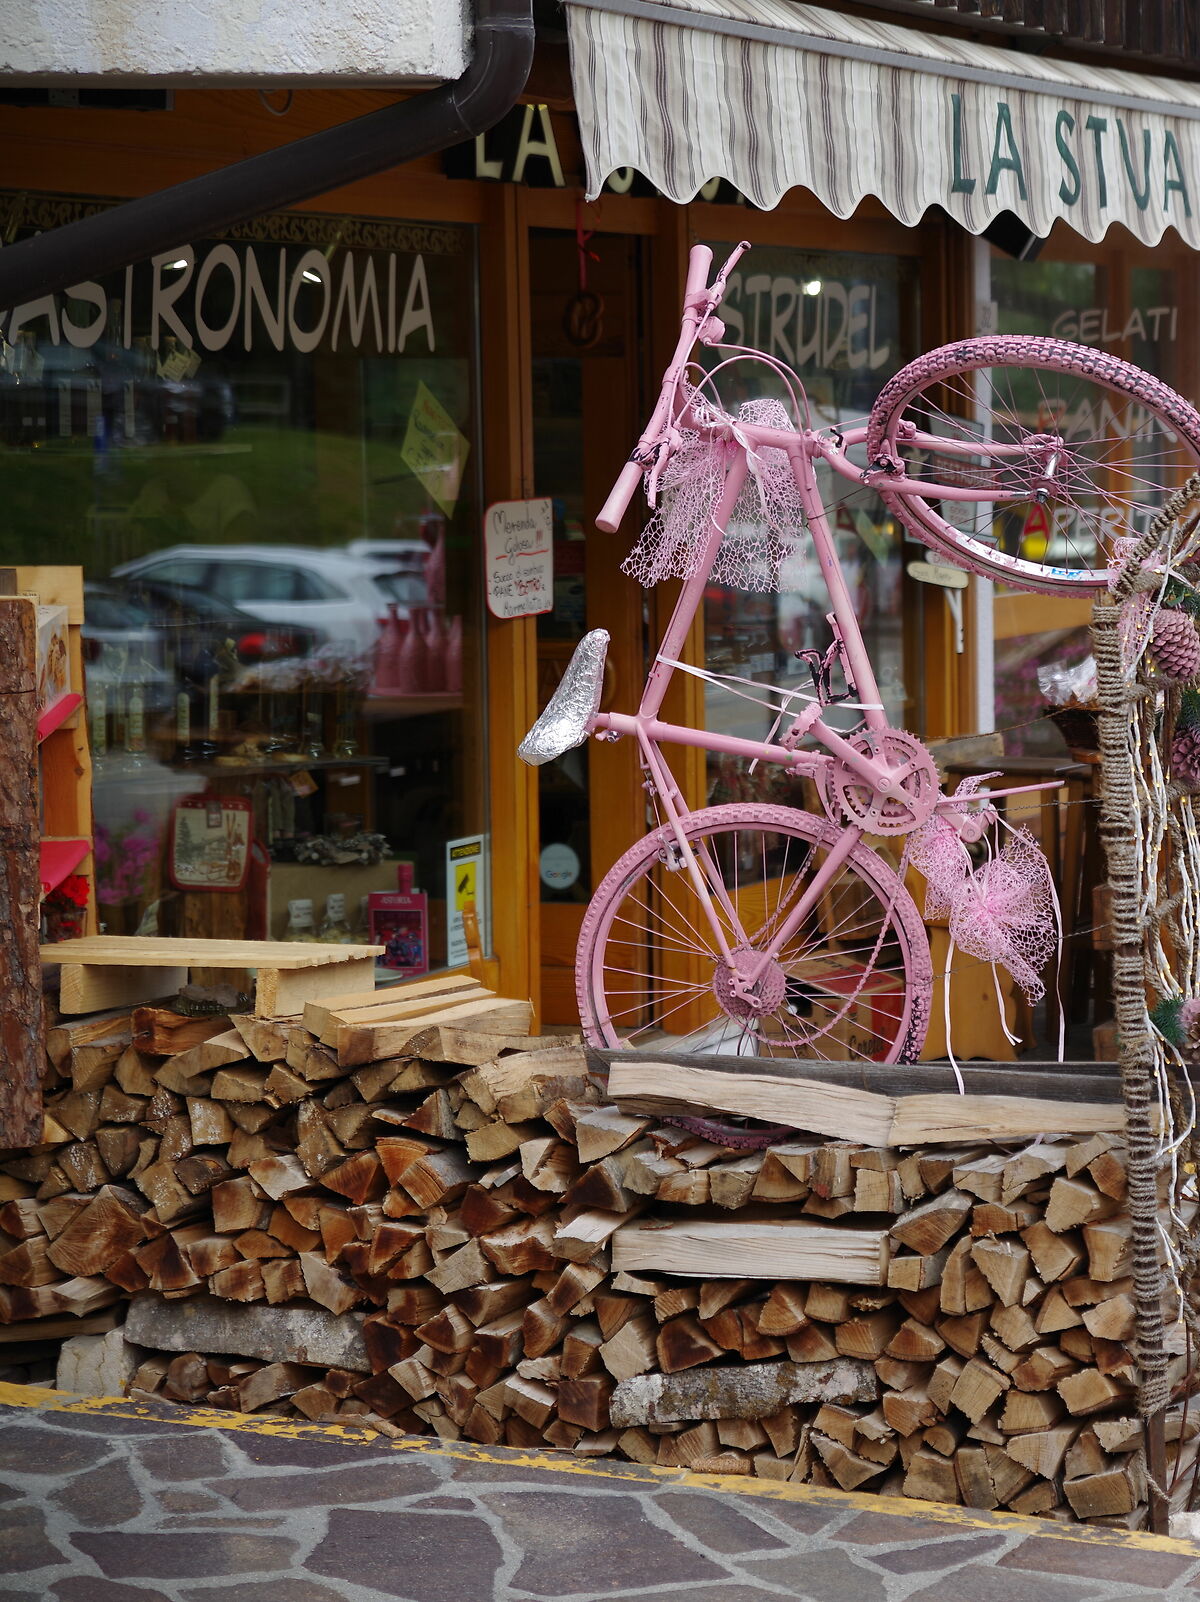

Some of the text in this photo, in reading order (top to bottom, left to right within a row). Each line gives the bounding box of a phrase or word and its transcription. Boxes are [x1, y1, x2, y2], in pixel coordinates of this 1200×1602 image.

[951, 93, 1028, 201] LA
[0, 244, 435, 353] ASTRONOMIA
[717, 272, 890, 370] STRUDEL
[1050, 307, 1178, 342] GELATI
